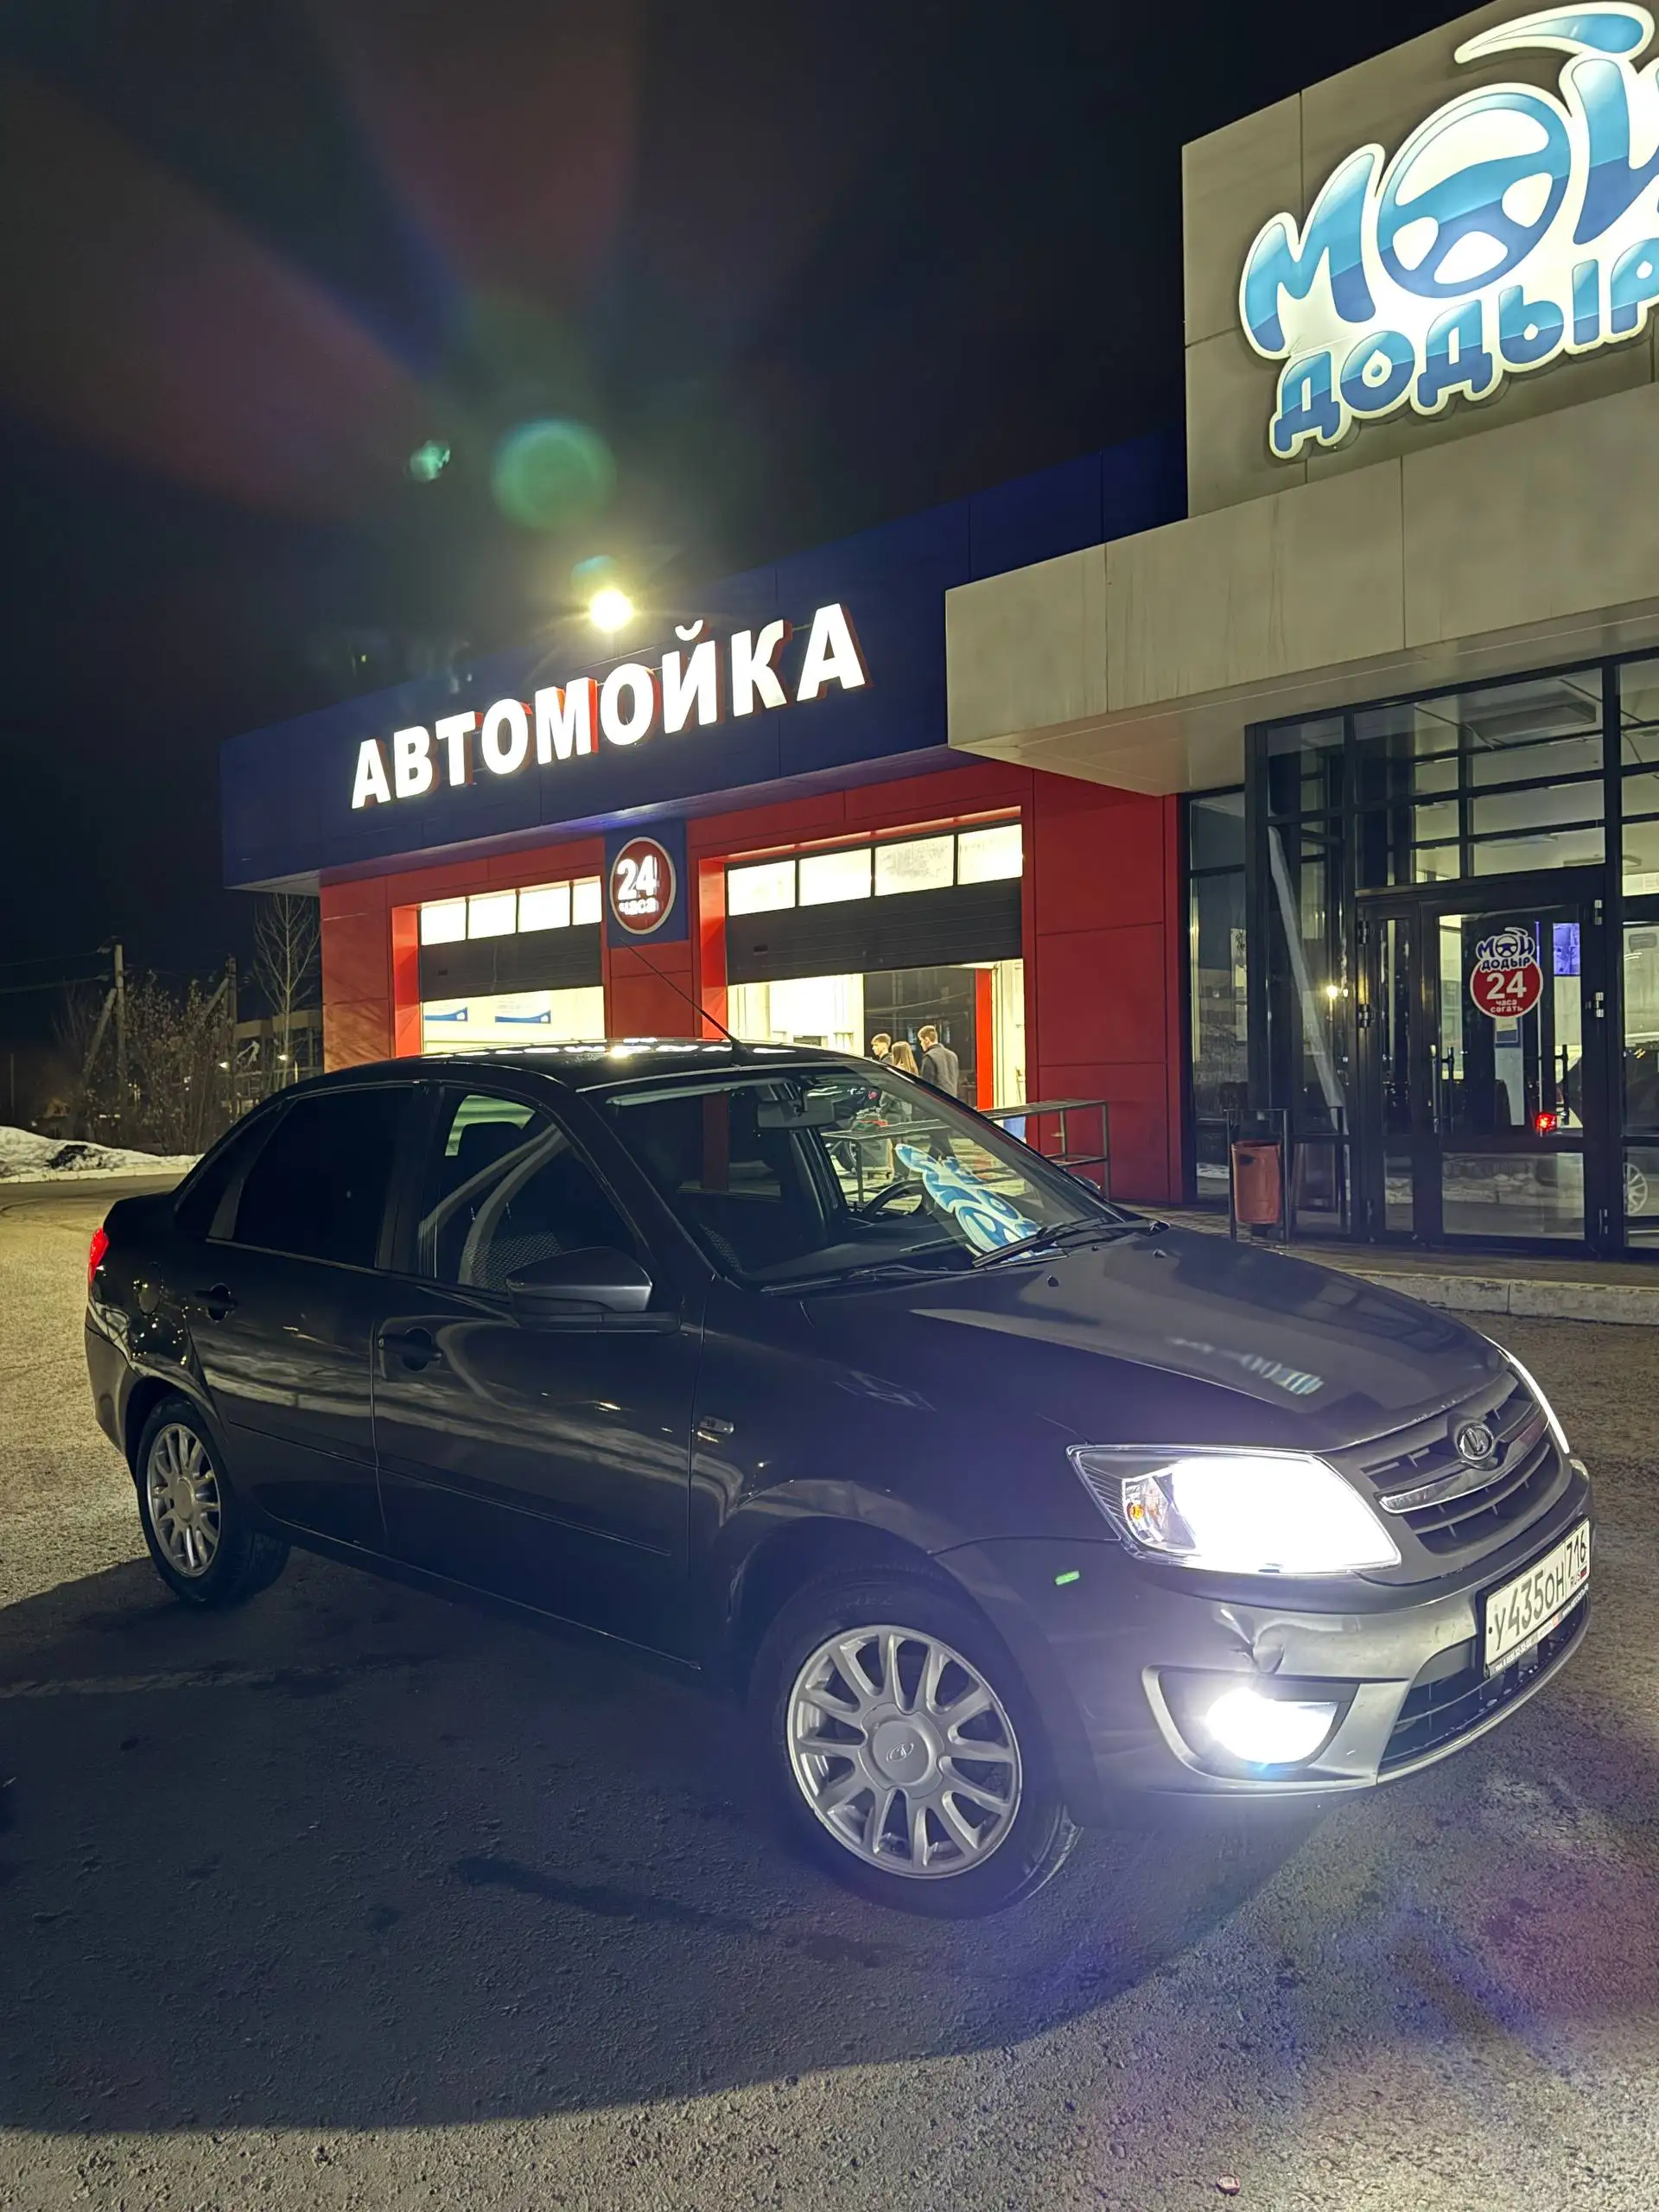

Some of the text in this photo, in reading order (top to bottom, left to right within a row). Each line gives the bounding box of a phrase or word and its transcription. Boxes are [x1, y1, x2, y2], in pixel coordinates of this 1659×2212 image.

[351, 602, 868, 810] АВТОМОЙКА
[616, 855, 658, 901] 24
[1481, 957, 1531, 971] ДОДЫР
[1485, 970, 1528, 1000] 24
[1566, 1529, 1588, 1577] 716
